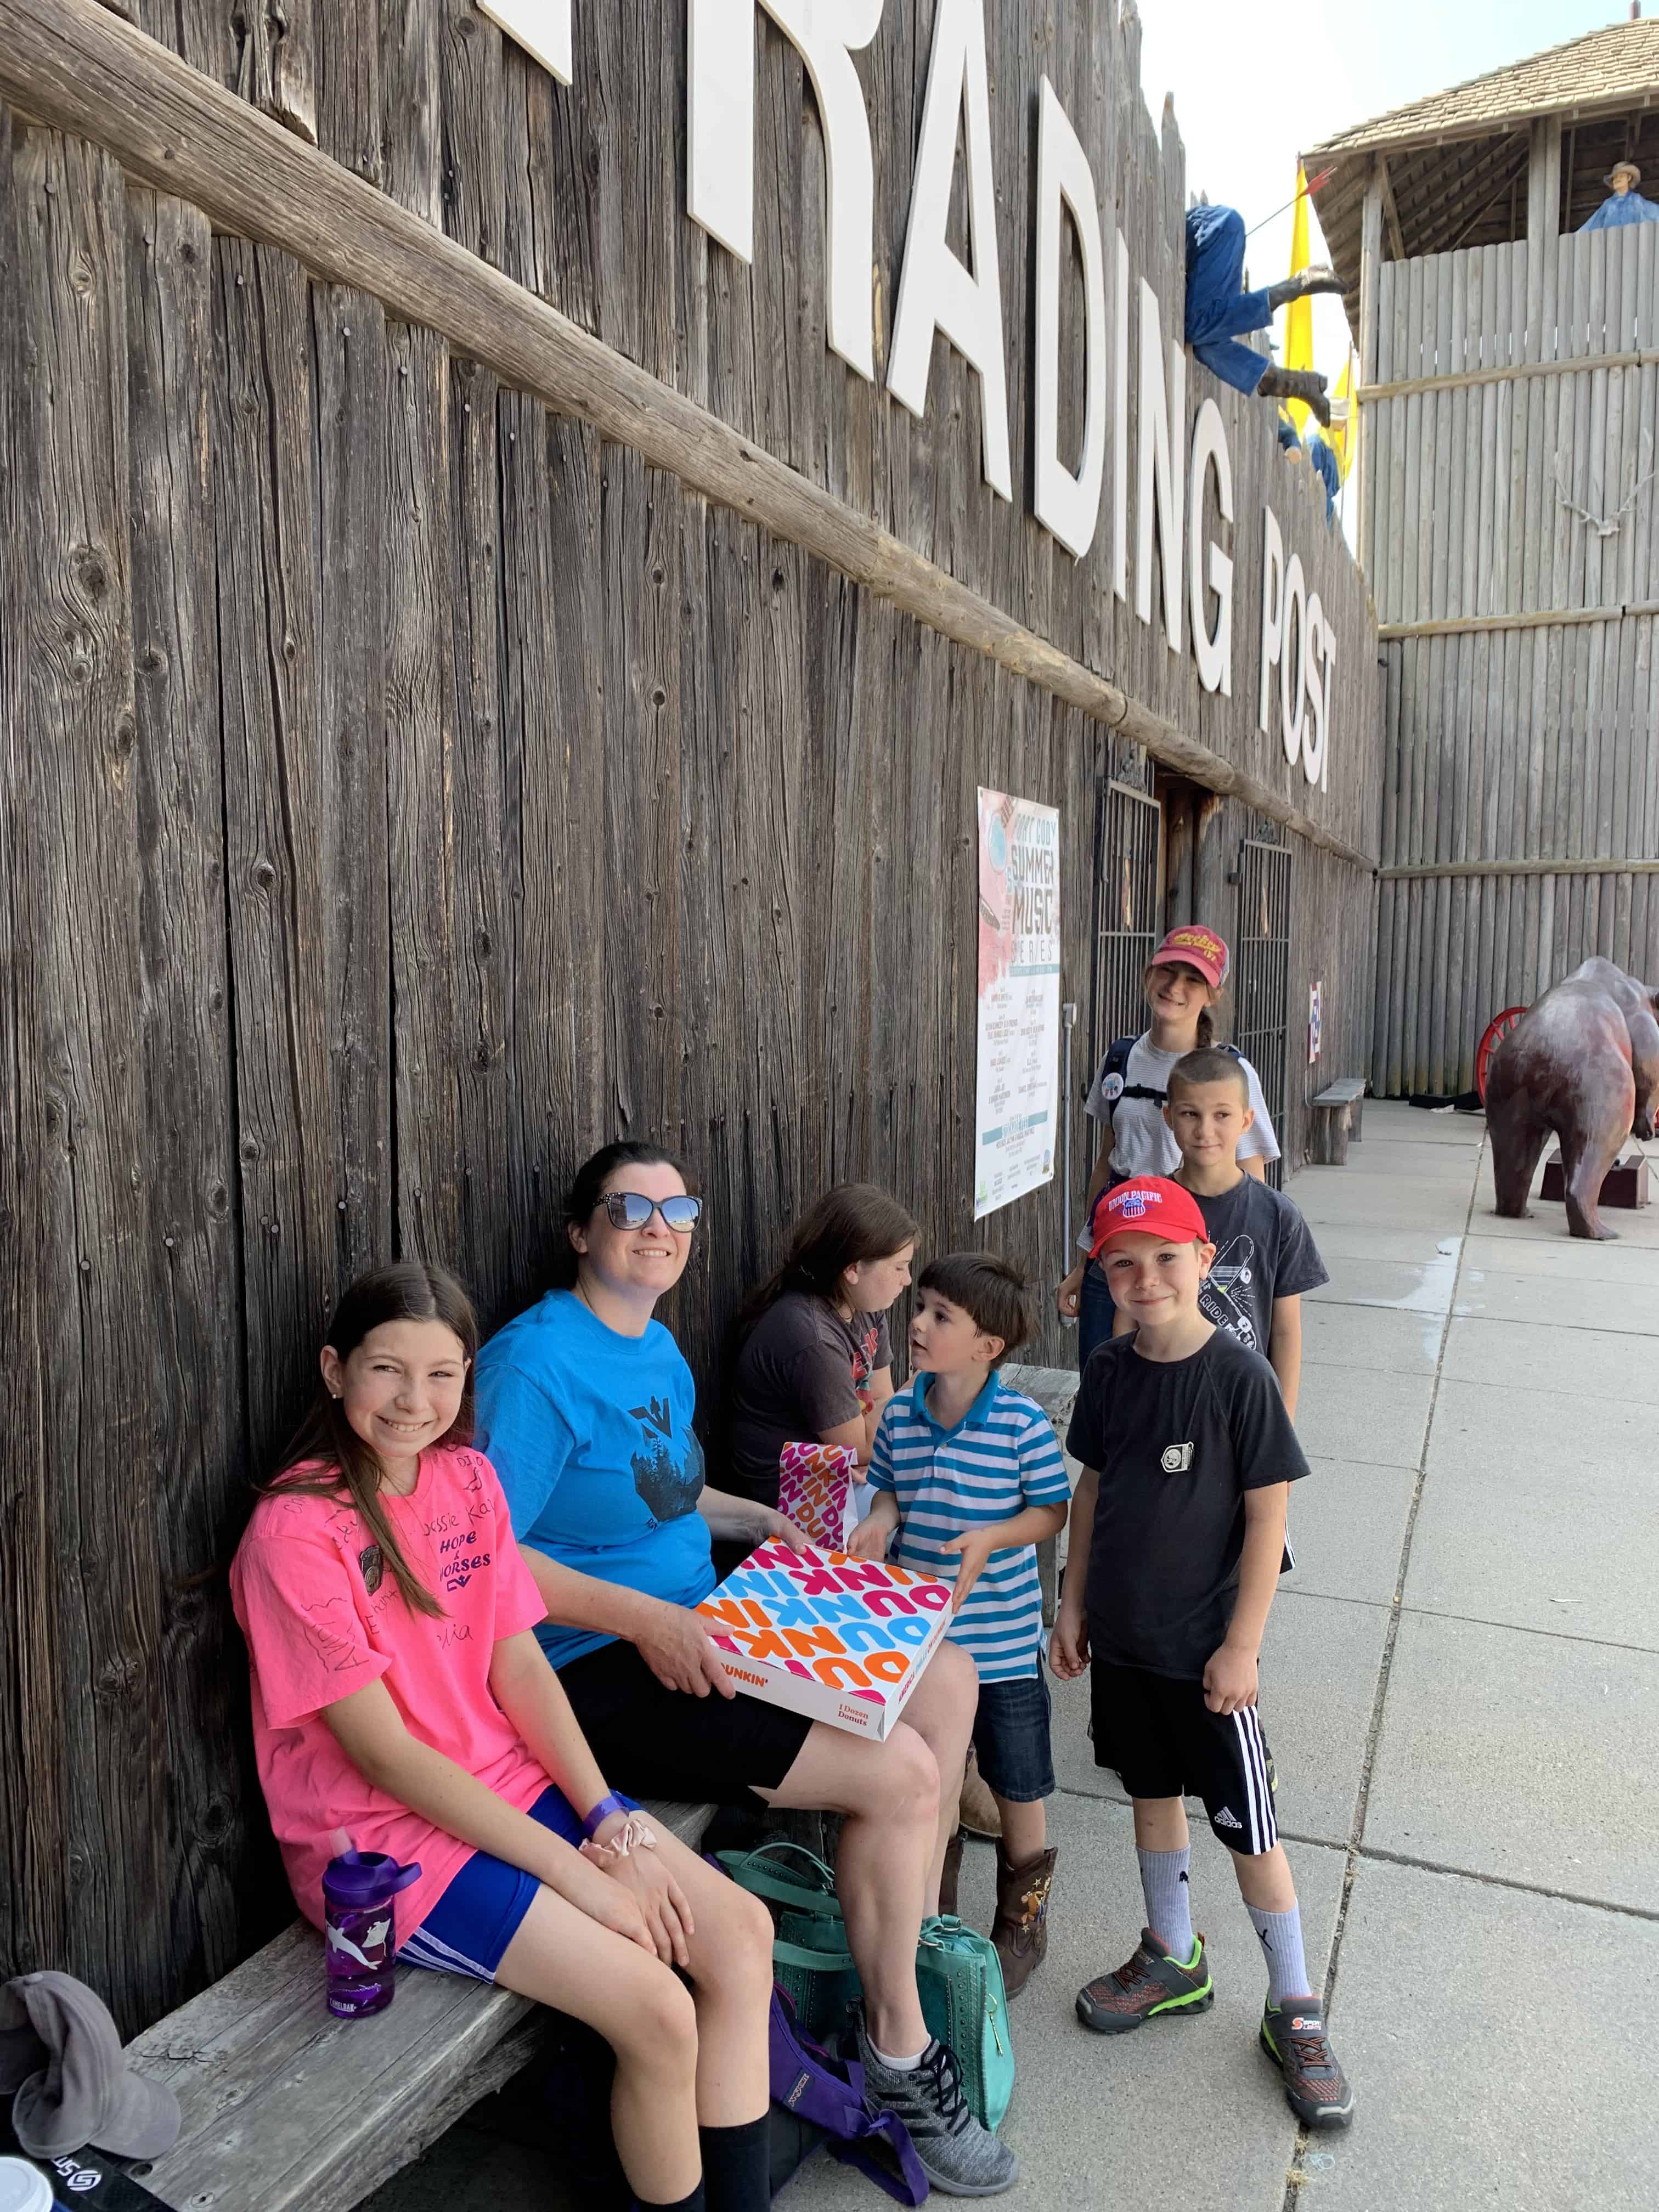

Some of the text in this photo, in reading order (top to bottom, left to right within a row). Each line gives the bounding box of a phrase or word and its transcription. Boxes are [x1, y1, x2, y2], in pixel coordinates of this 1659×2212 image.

[476, 0, 1336, 793] RADING POST
[1036, 818, 1056, 846] CODY
[1011, 844, 1054, 885] SUMMER
[1012, 887, 1053, 935] MUSIC
[1010, 939, 1053, 963] SERIES
[1108, 1192, 1129, 1212] UNION
[1131, 1190, 1163, 1203] PACIFIC
[1199, 1294, 1229, 1327] RIDE
[721, 1662, 768, 1688] UNKIN'
[838, 1711, 867, 1726] Donuts
[844, 1705, 869, 1719] Dozen
[1214, 1815, 1243, 1829] adidas
